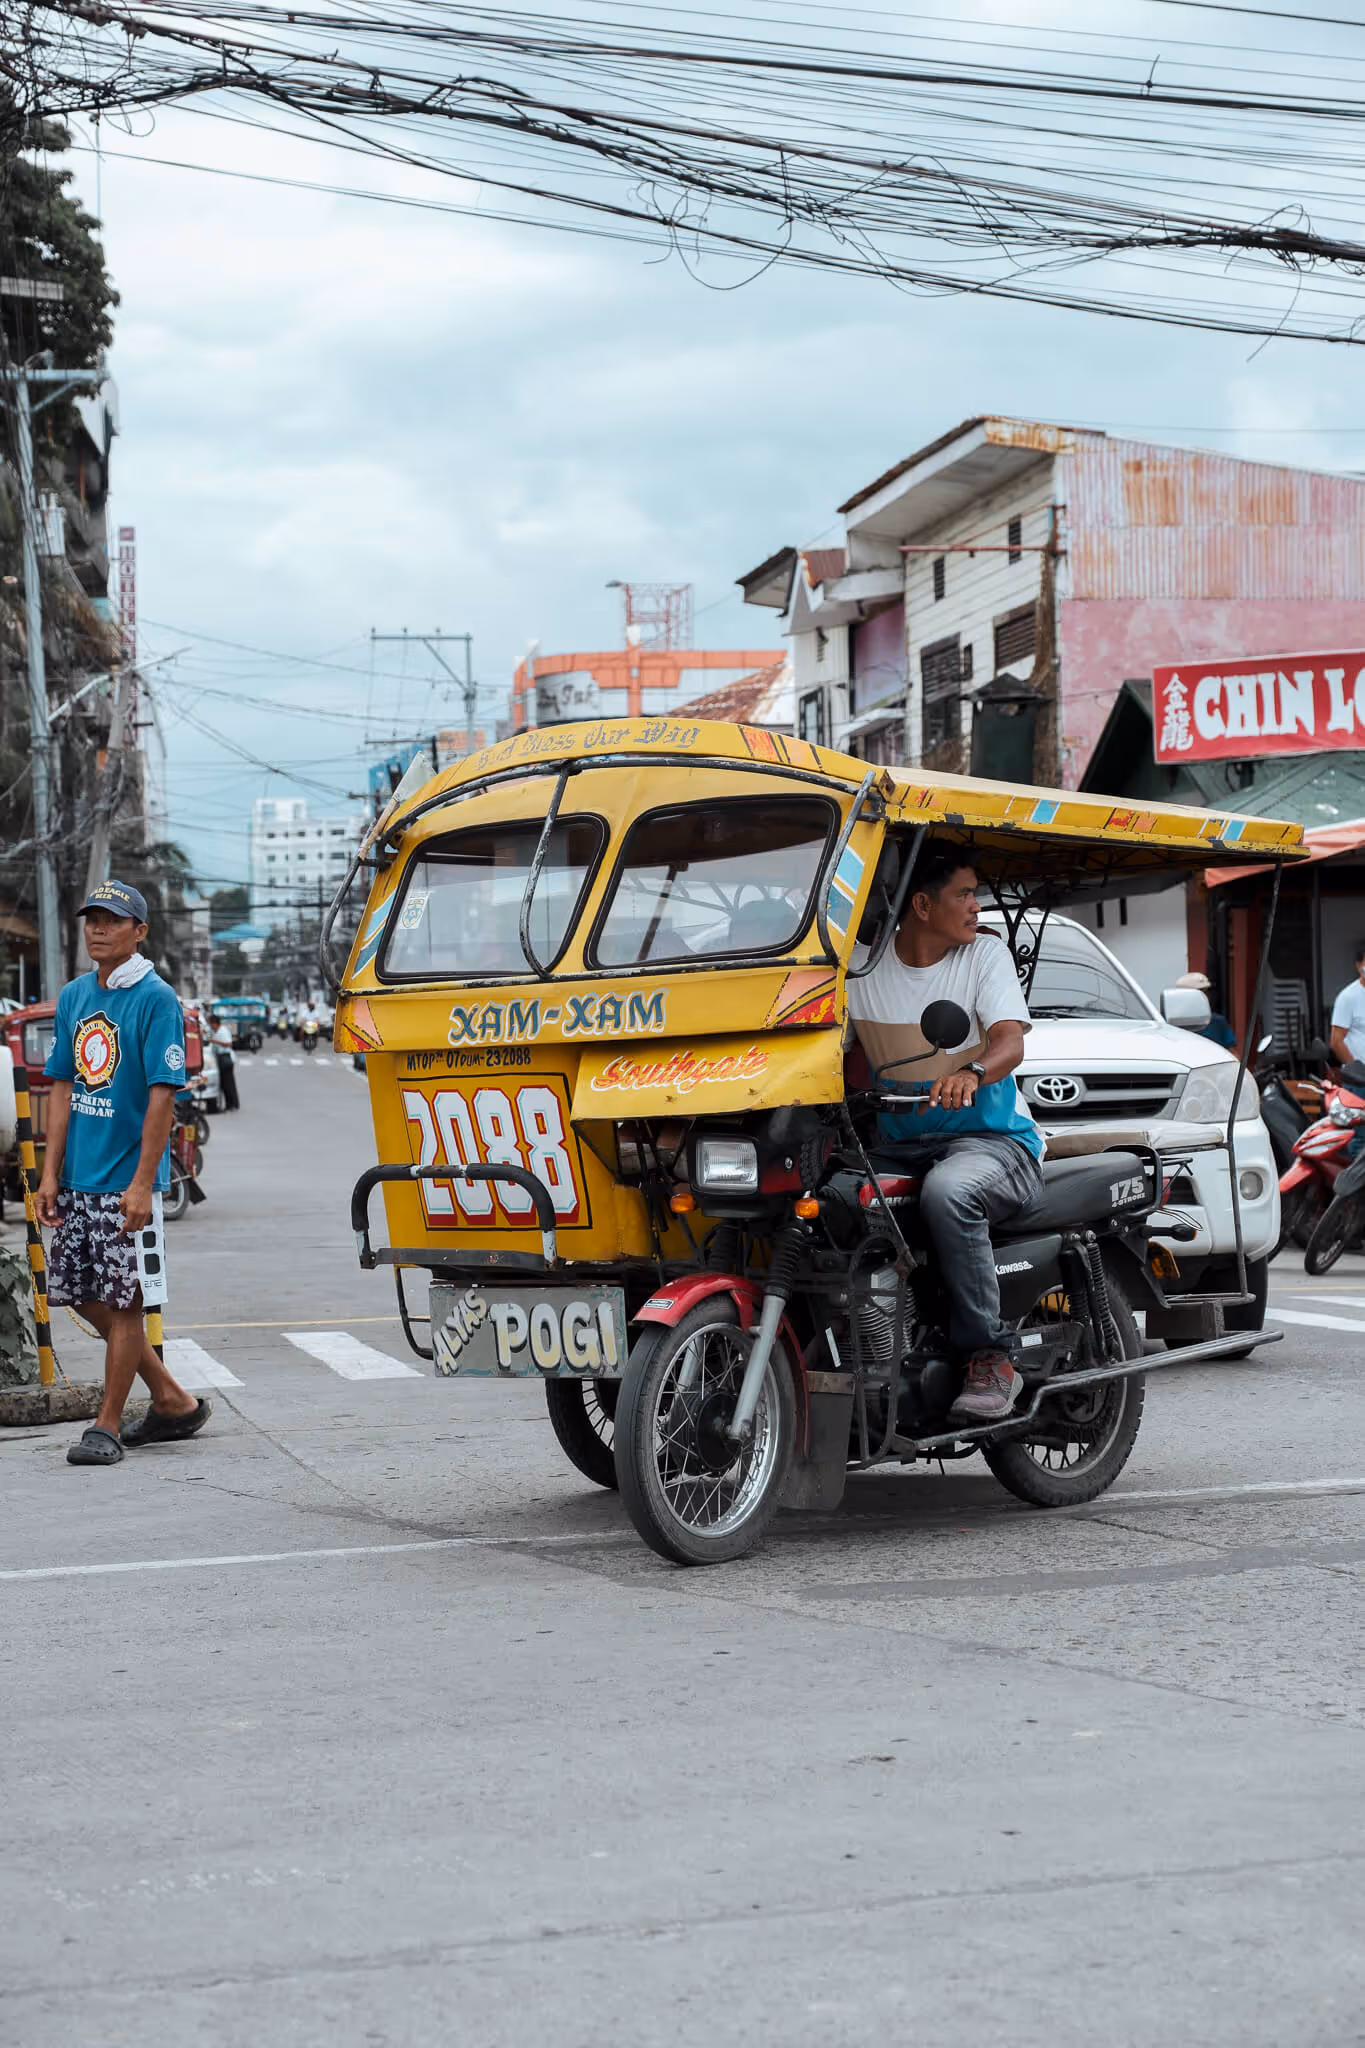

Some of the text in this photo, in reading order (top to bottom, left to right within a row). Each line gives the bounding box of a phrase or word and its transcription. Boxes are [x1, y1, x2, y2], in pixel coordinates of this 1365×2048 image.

[1194, 671, 1315, 740] CHIN
[448, 988, 670, 1046] XAM-XAM
[591, 1045, 770, 1094] Southgate
[402, 1085, 580, 1226] 2088
[1110, 1176, 1144, 1202] 175
[433, 1289, 618, 1376] ALYAS POGI
